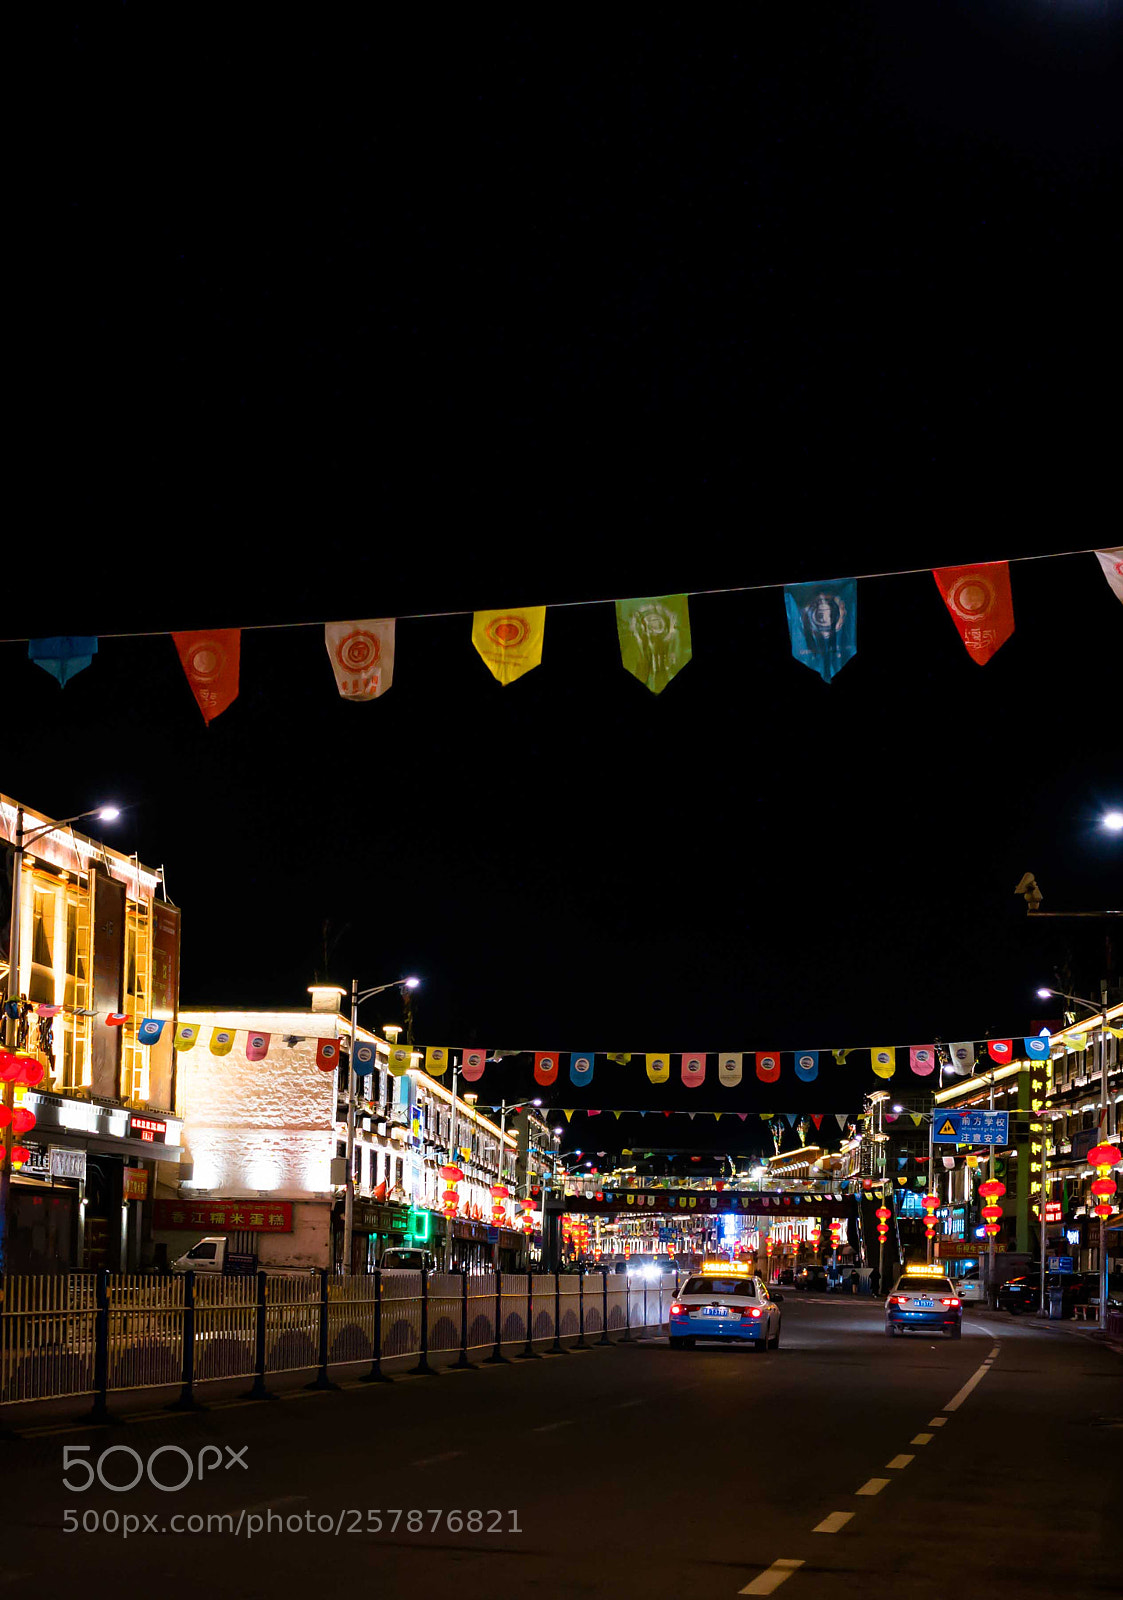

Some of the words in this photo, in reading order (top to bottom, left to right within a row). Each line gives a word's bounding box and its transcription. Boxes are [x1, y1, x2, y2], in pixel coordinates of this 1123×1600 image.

[961, 1116, 1005, 1127] 前方学校
[961, 1133, 1004, 1144] 注意安全
[172, 1211, 285, 1226] 香江糯米蛋糕
